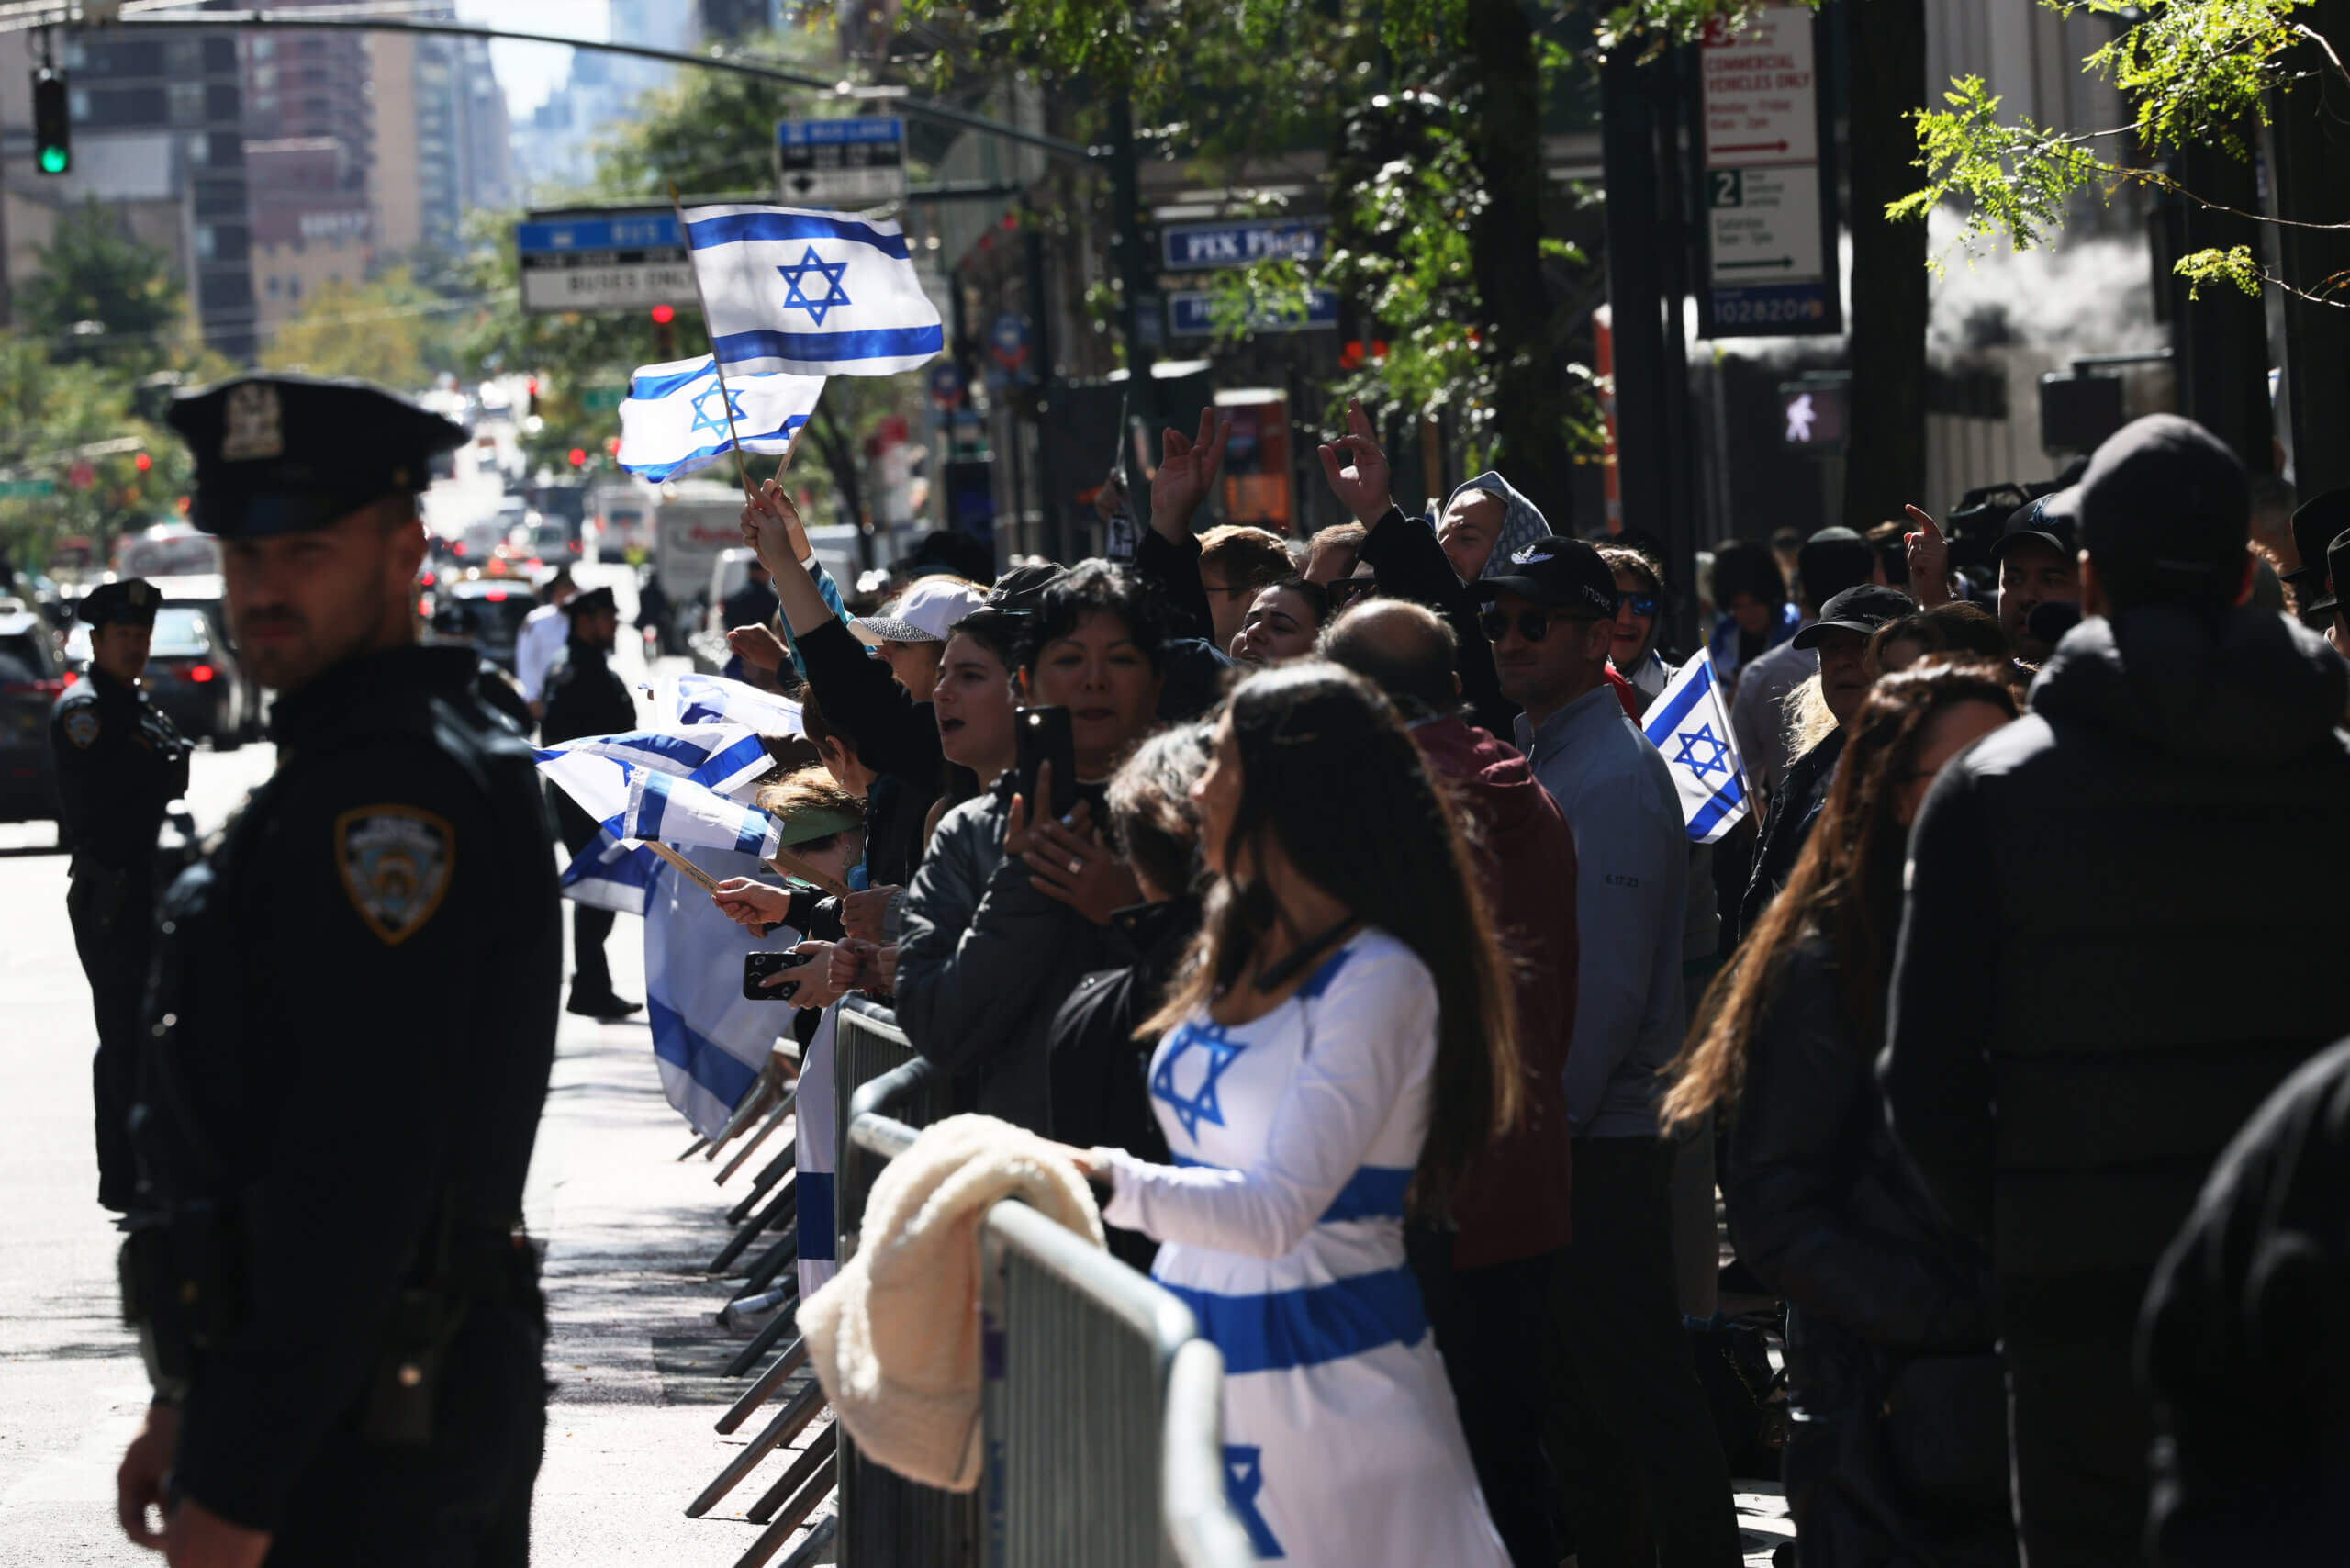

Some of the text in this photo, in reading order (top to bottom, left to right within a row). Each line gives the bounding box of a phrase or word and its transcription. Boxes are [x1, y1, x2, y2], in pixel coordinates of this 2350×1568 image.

[1775, 73, 1810, 89] ONLY
[1717, 172, 1735, 205] 2
[1187, 232, 1238, 261] PIX
